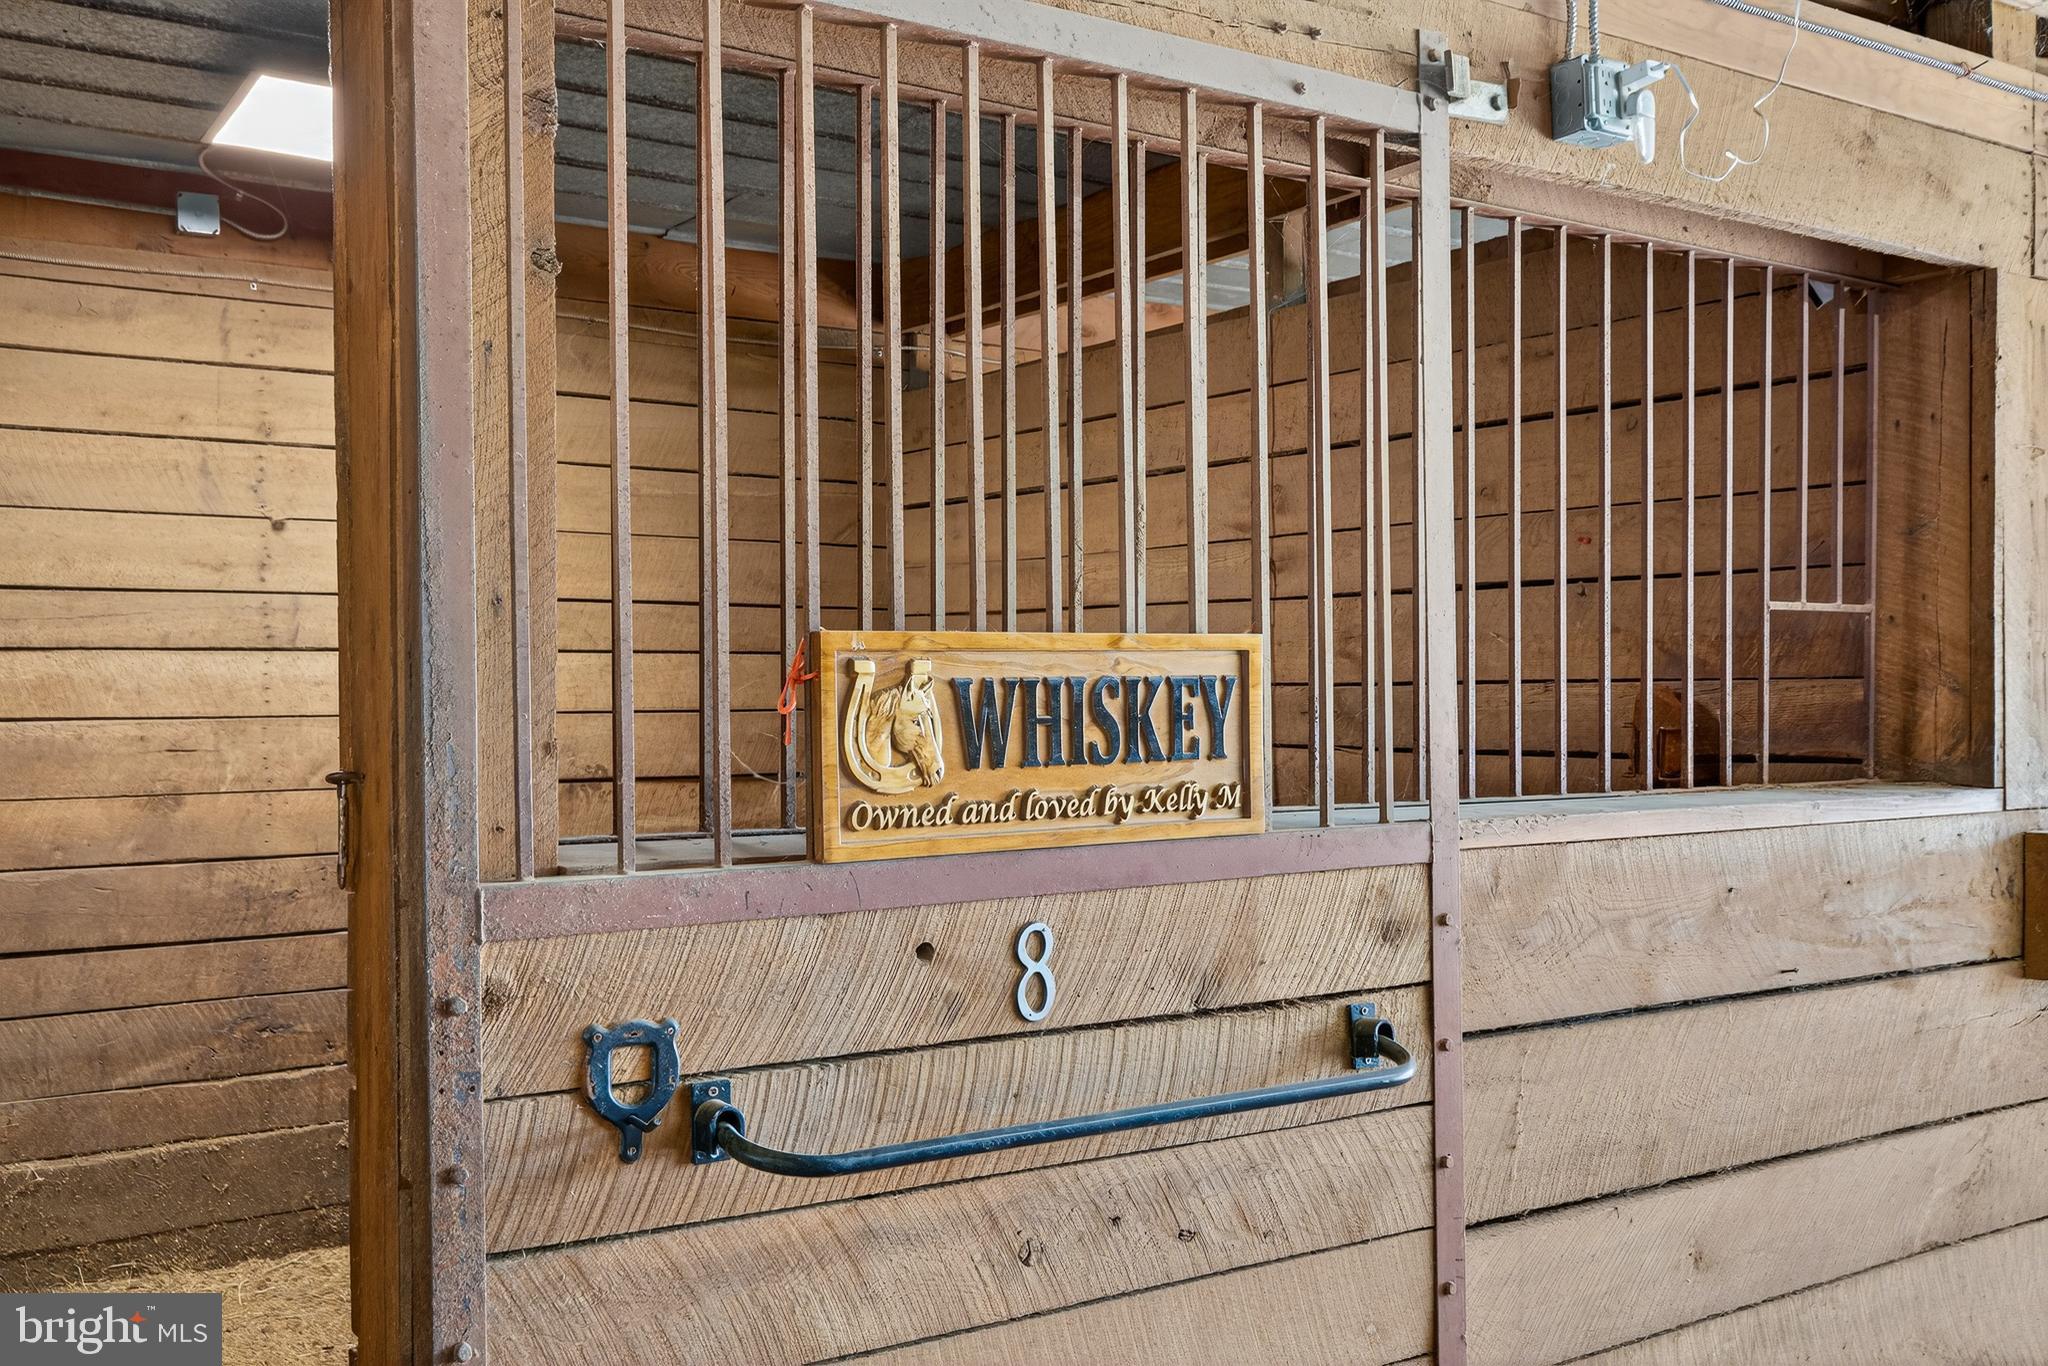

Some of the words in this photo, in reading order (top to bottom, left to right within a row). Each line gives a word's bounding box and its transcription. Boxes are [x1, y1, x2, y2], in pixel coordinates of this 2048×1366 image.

[951, 676, 1237, 769] WHISKEY
[850, 792, 958, 831] Owned
[960, 789, 1021, 825] and
[1024, 786, 1101, 820] loved
[1103, 784, 1135, 824] by
[1140, 780, 1209, 820] Kelly
[1213, 783, 1242, 810] M
[1016, 921, 1057, 1022] 8
